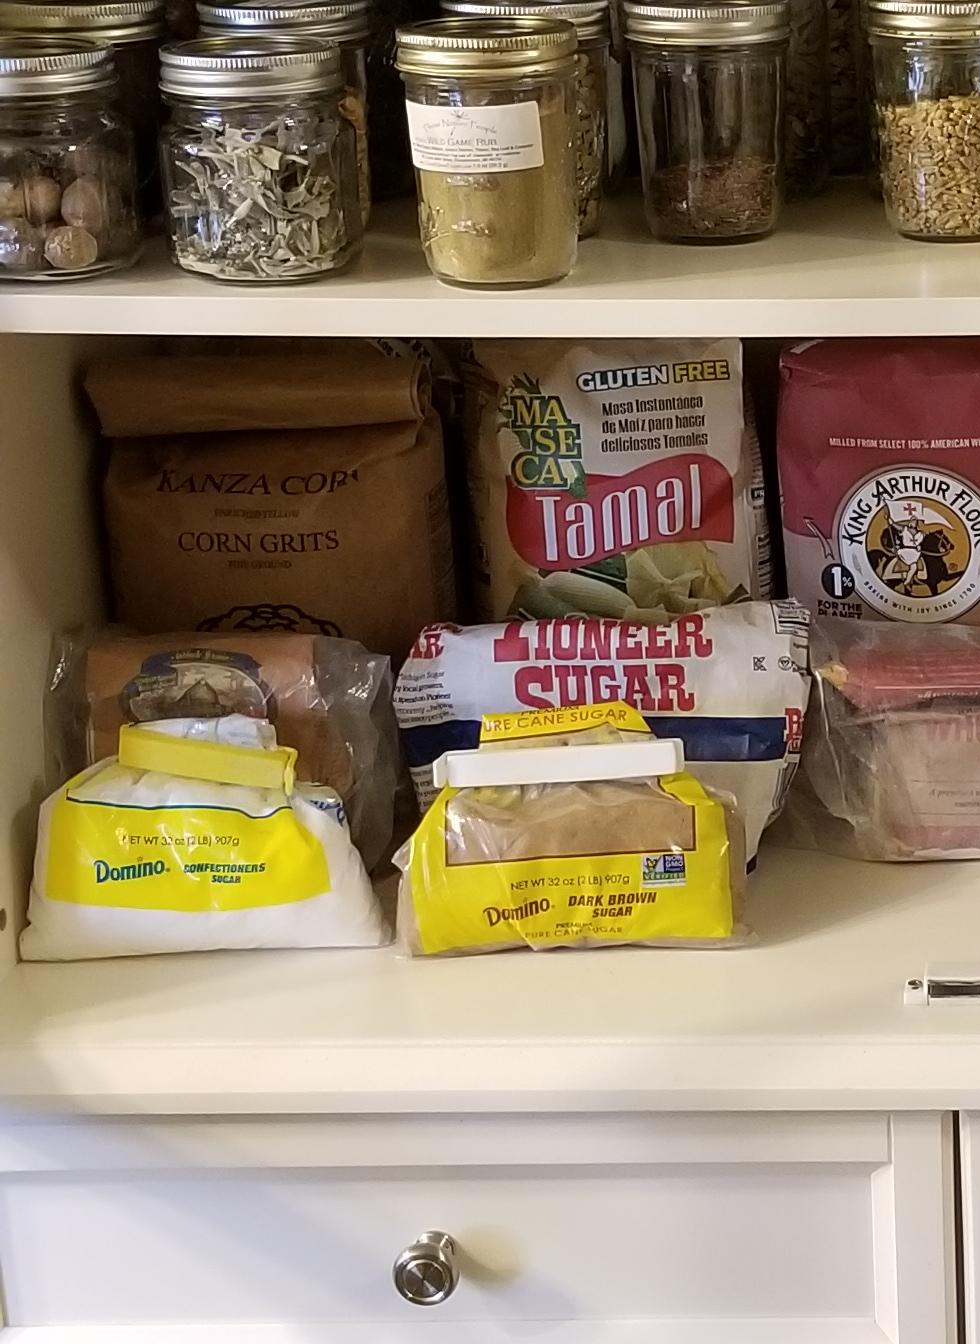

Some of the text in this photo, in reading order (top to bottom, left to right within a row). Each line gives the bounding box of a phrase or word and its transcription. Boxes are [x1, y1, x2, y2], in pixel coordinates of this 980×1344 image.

[576, 360, 730, 393] GLUTEN FREE
[602, 414, 706, 434] de para hacer
[601, 432, 708, 453] deliciosos Tamales
[829, 437, 856, 448] MILLED
[857, 438, 878, 448] FROM
[879, 439, 905, 449] SELECT
[908, 439, 929, 449] 100%
[931, 437, 970, 448] AMERICAN
[156, 469, 271, 495] KANZA
[535, 463, 702, 562] Tamal
[842, 498, 873, 547] KING
[872, 475, 951, 506] ARTHUR
[178, 530, 339, 554] CORN GRITS
[493, 614, 713, 663] PIONEER
[514, 664, 696, 712] SUGAR
[517, 709, 628, 729] CANE SUGAR
[144, 835, 240, 848] WT 907g
[94, 859, 165, 884] Domino
[184, 863, 266, 873] CONFECTIONERS
[211, 875, 241, 883] SUGAR
[511, 874, 630, 891] NET WT 32 oz 907g
[568, 892, 657, 907] DARK BROWN
[483, 898, 551, 928] Domino
[592, 906, 632, 918] SUGAR
